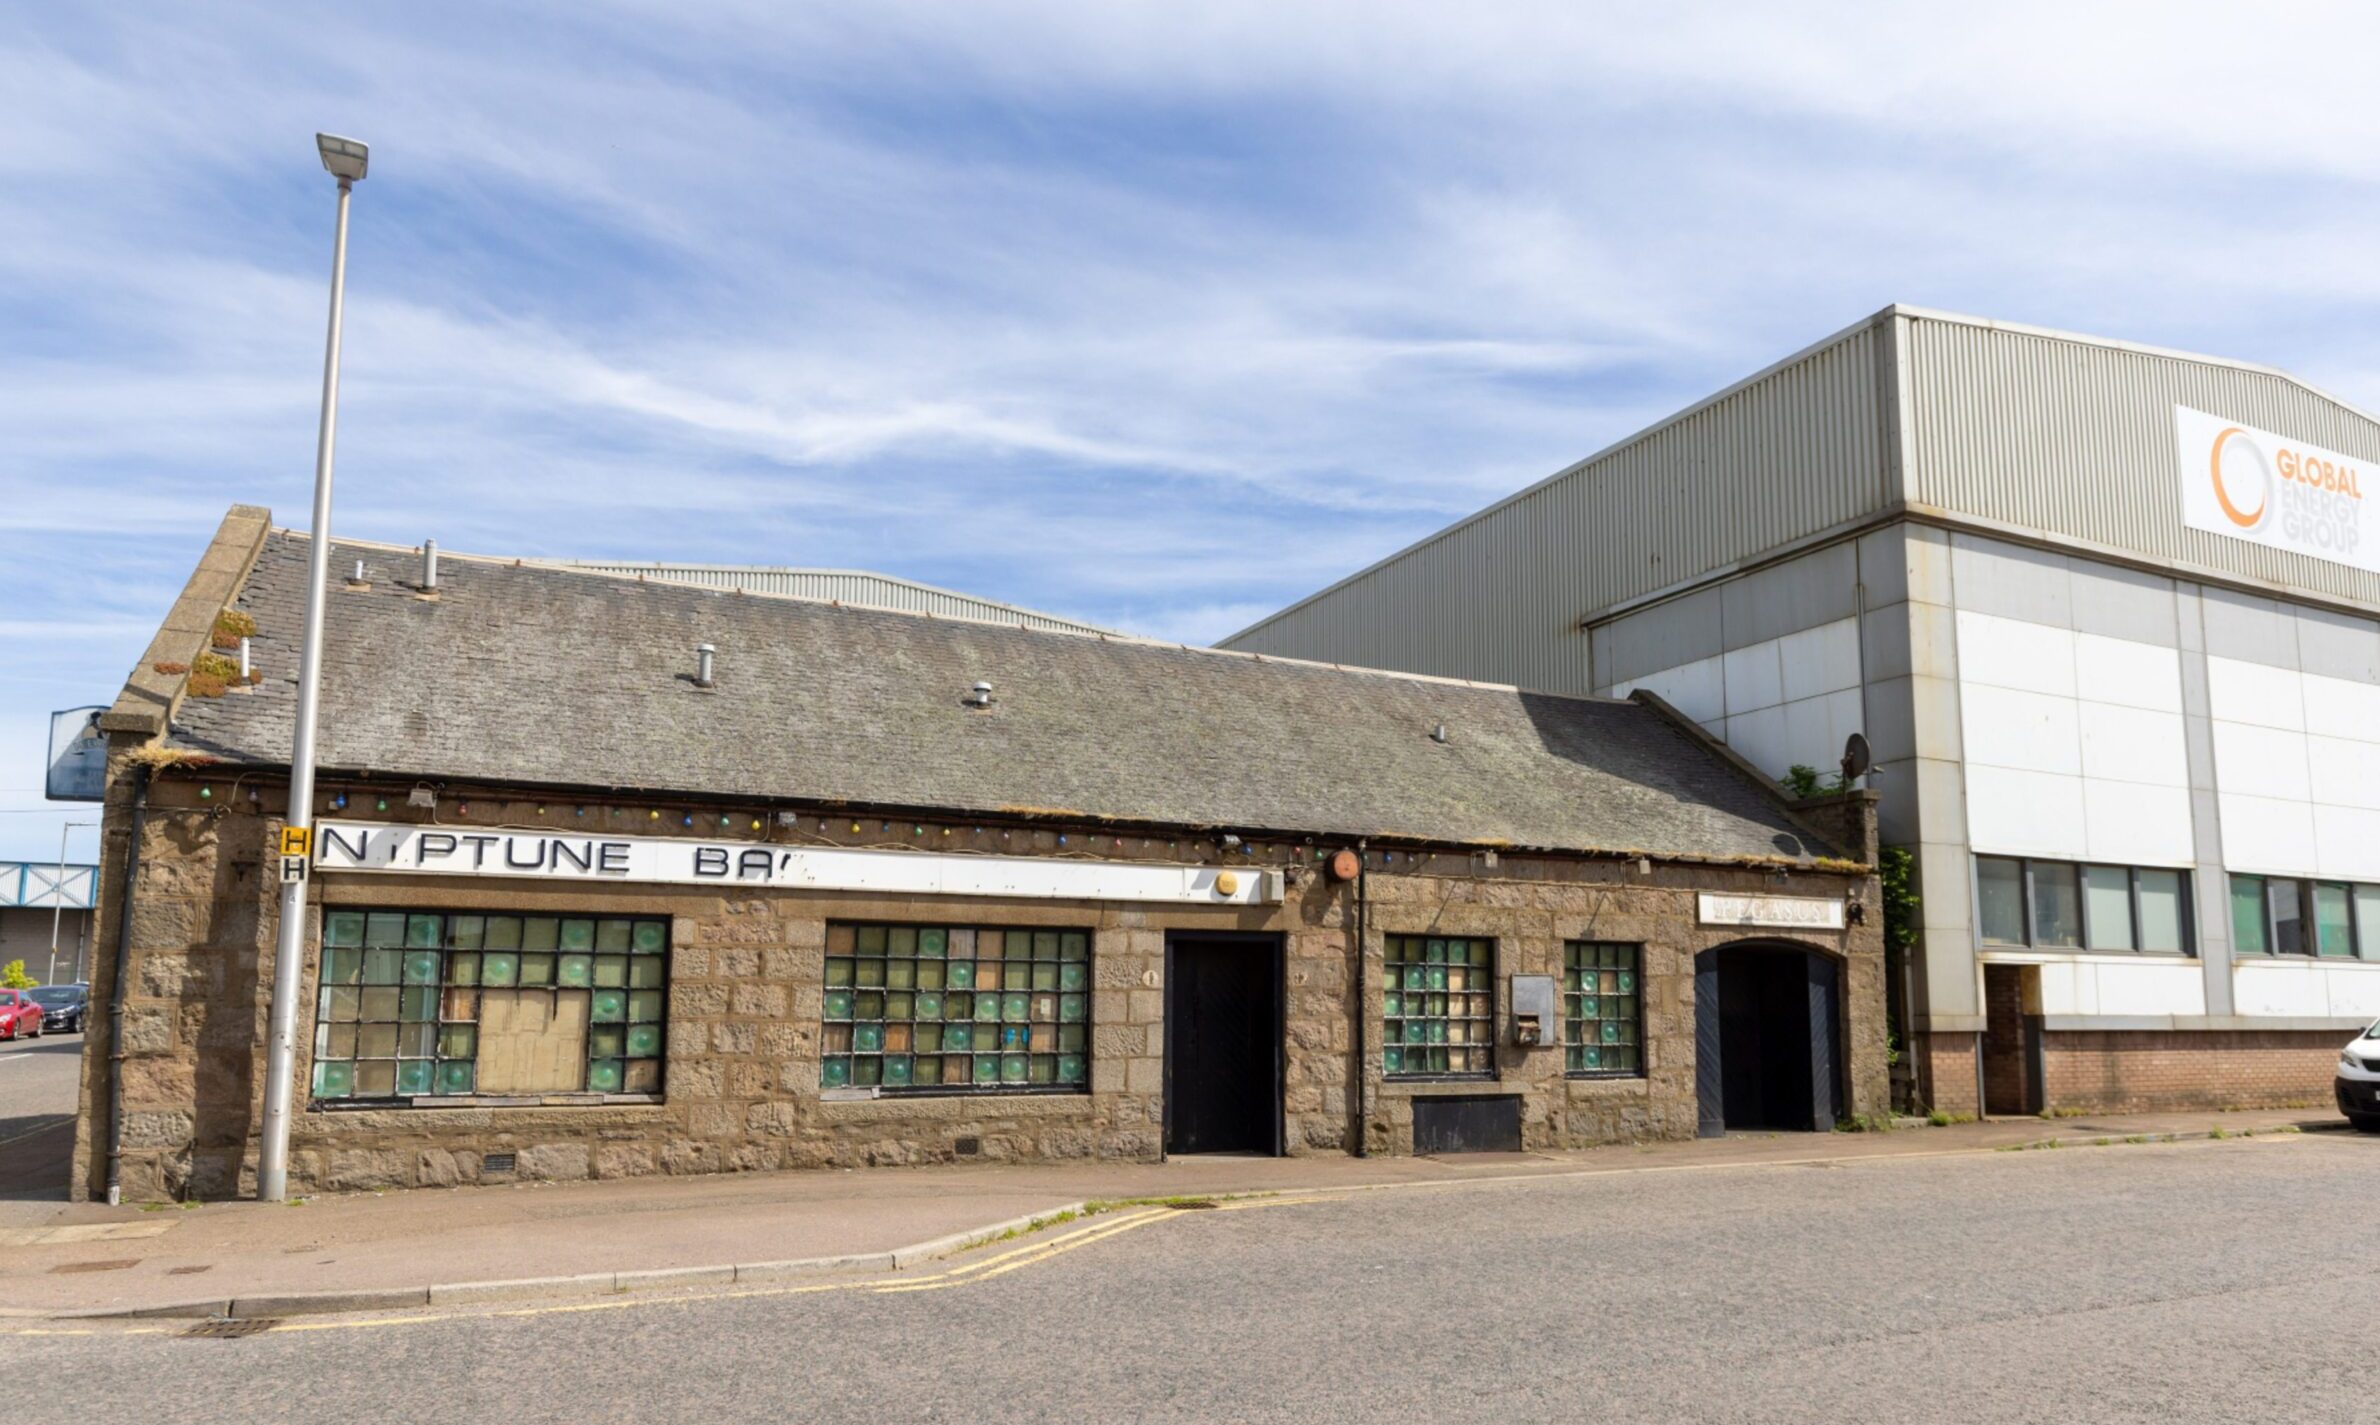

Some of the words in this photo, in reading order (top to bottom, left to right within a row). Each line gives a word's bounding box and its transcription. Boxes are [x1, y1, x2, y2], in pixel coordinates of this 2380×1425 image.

[2276, 448, 2362, 500] GLOBAL
[2281, 480, 2360, 526] ENERGY
[2282, 510, 2359, 555] GROUP
[285, 830, 307, 852] H
[283, 858, 305, 880] H
